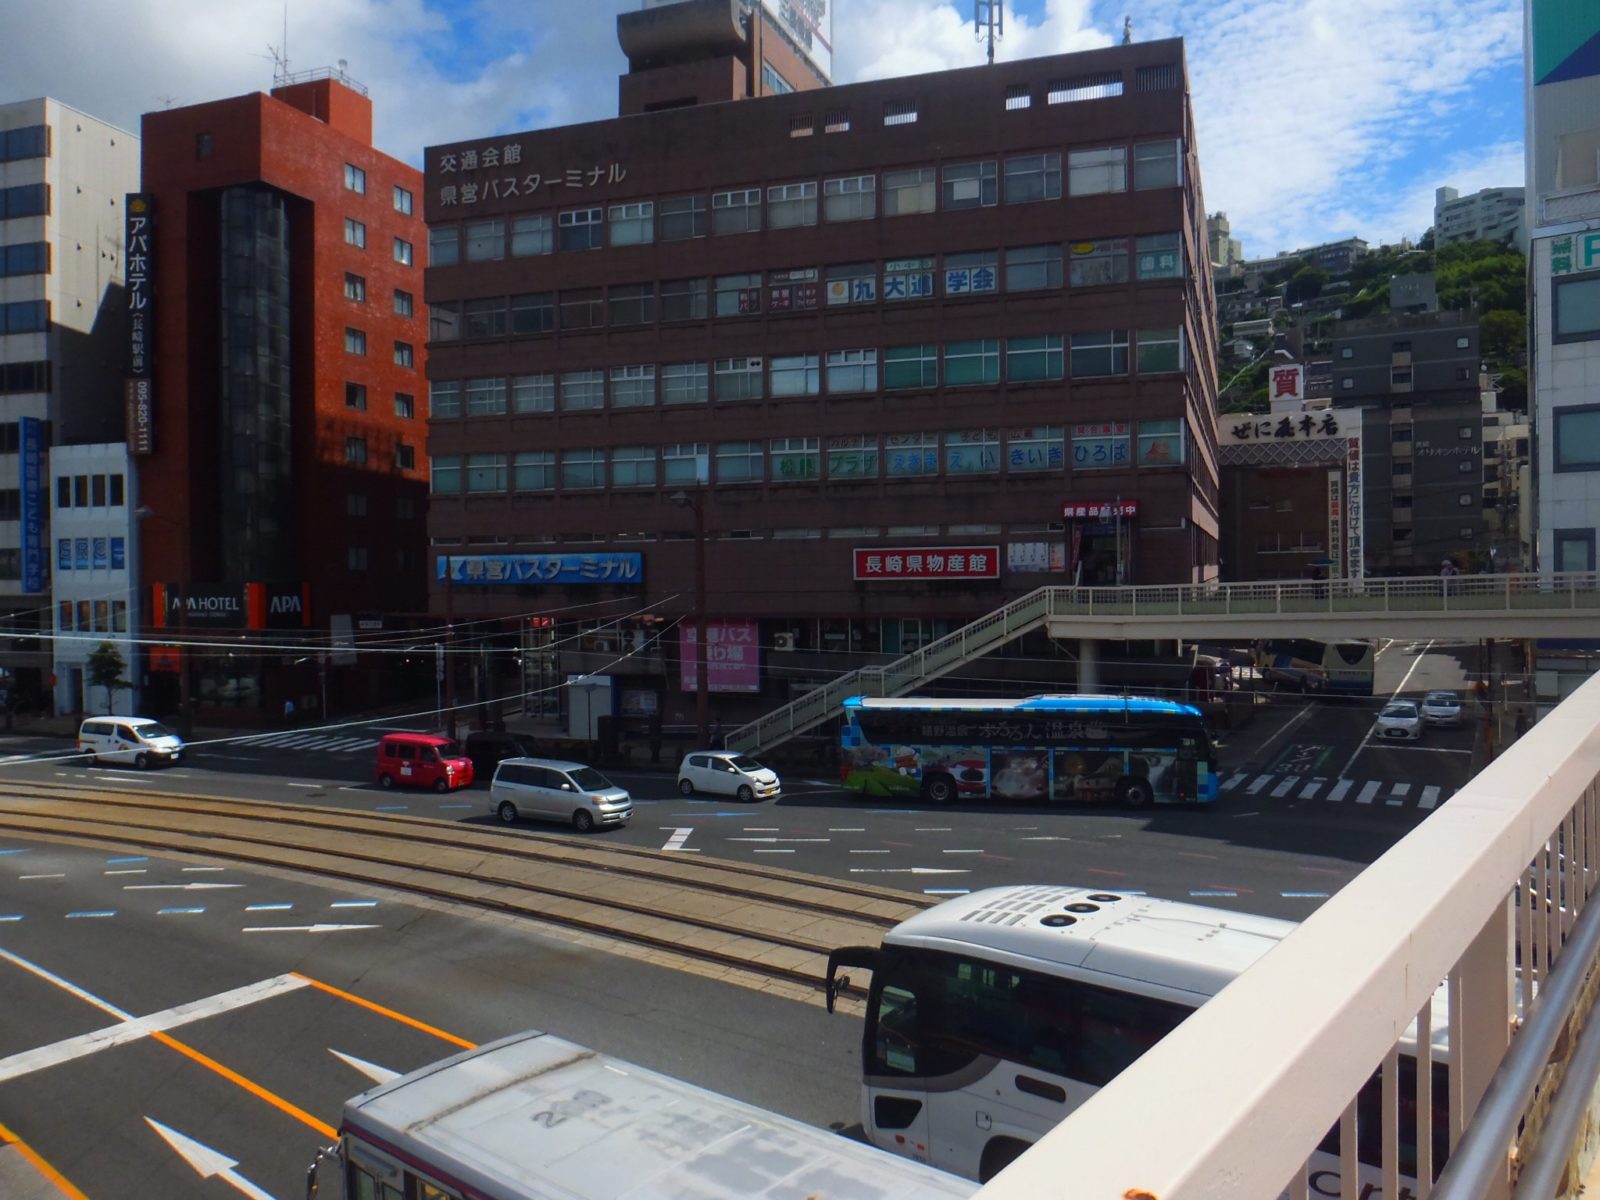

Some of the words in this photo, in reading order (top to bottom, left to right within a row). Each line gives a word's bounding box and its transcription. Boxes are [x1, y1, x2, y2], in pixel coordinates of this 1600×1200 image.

[440, 143, 522, 174] 交通会館
[440, 163, 626, 207] 県営バスターミナル
[128, 216, 147, 310] アパホテル
[1272, 368, 1300, 398] 質
[466, 556, 637, 580] 県営バスターミナル
[865, 552, 988, 573] 長崎県物産館
[198, 596, 240, 611] HOTEL
[270, 595, 302, 613] APA
